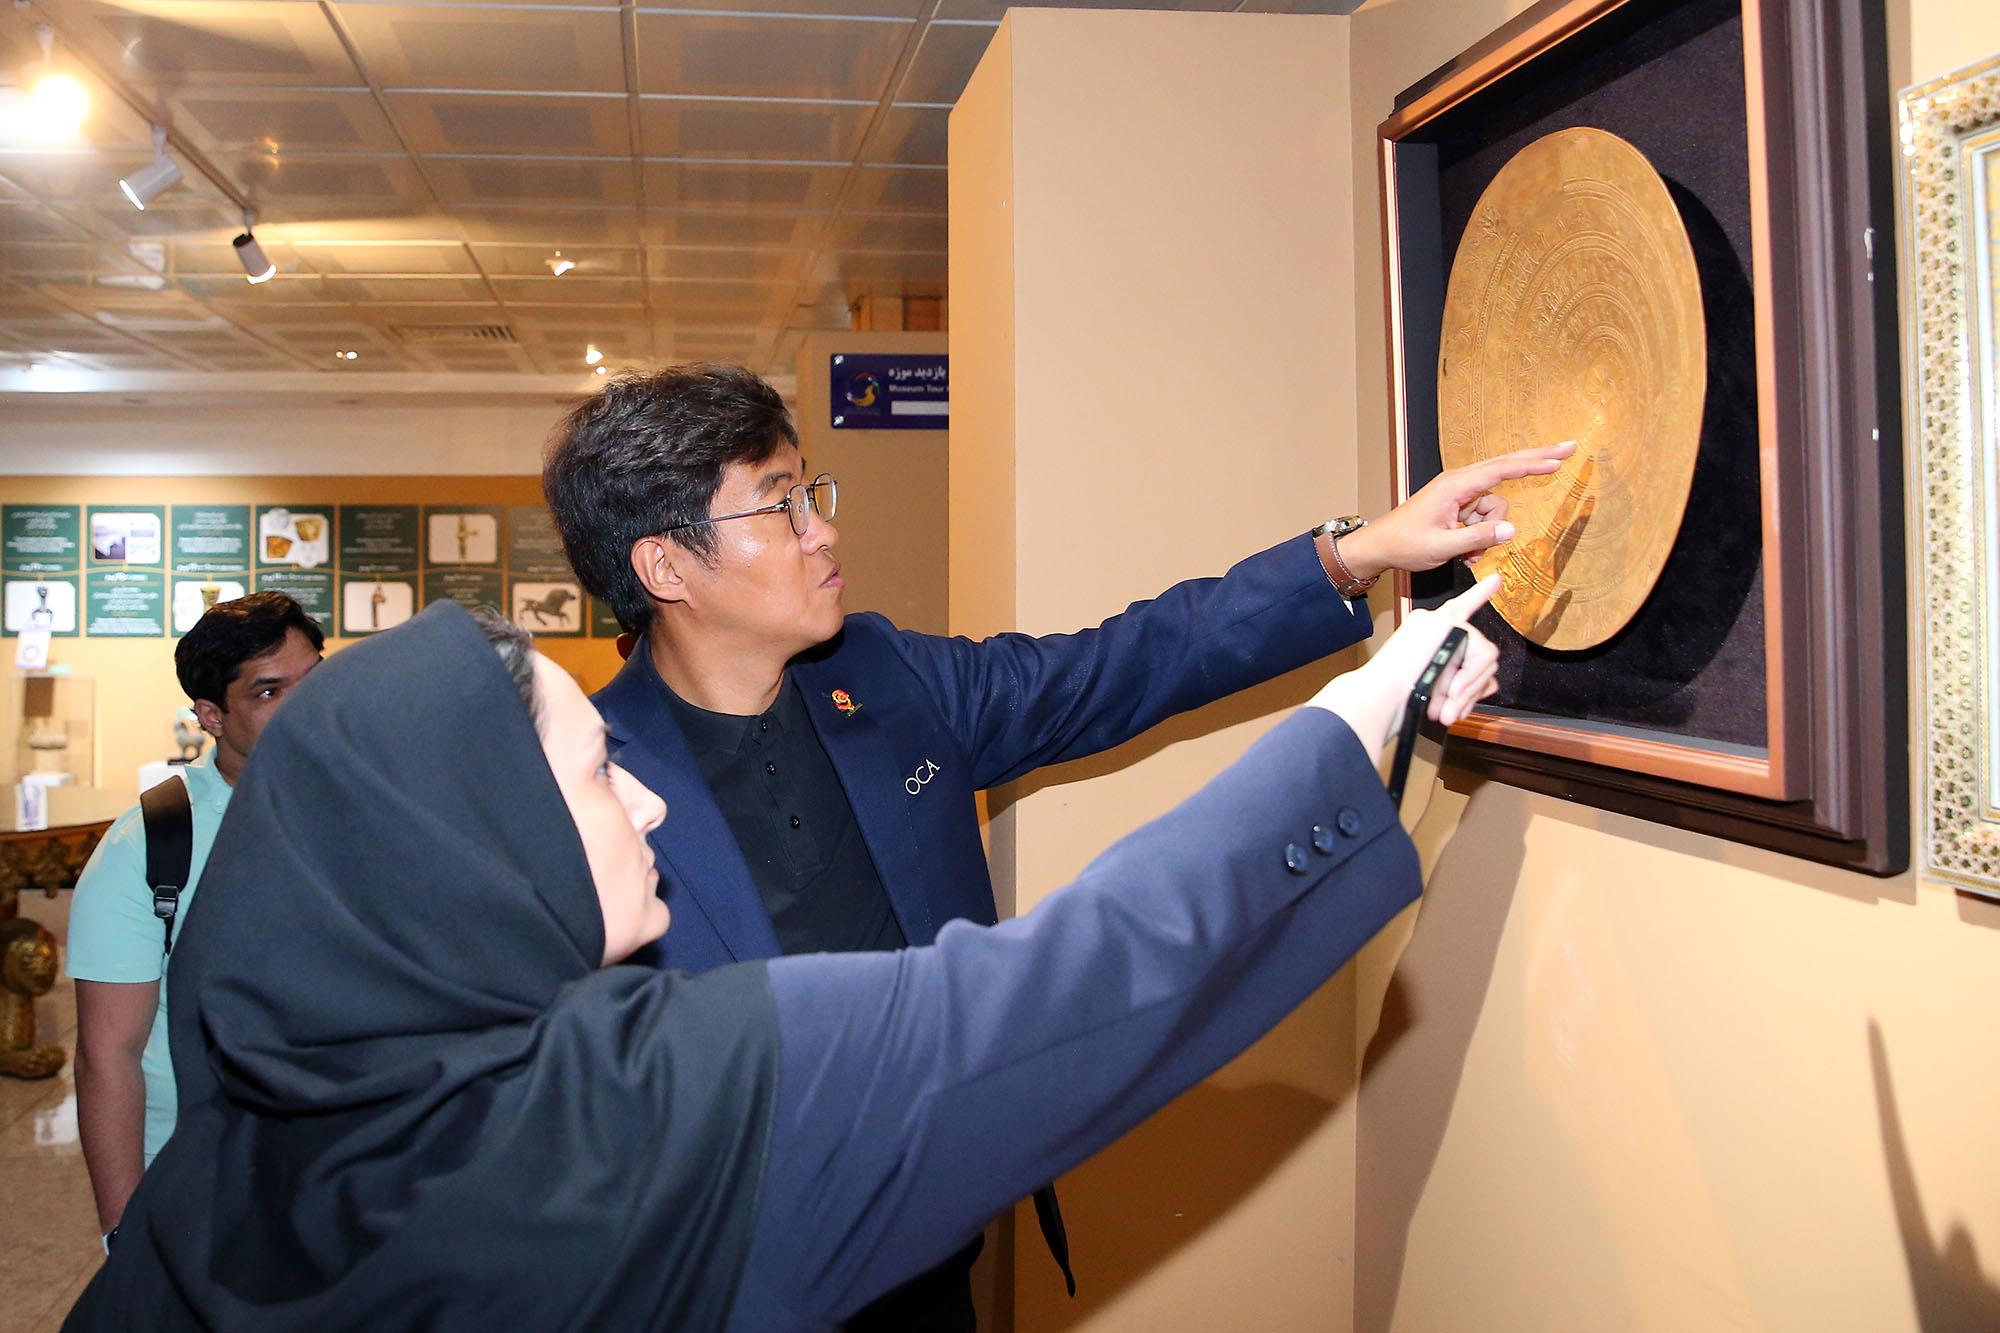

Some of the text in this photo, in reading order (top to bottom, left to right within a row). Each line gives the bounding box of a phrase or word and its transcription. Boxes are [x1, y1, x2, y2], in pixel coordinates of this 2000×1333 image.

[888, 366, 946, 380] بازدید موزه
[888, 384, 924, 393] Museum
[926, 384, 945, 393] Tour
[904, 758, 941, 795] OCA
